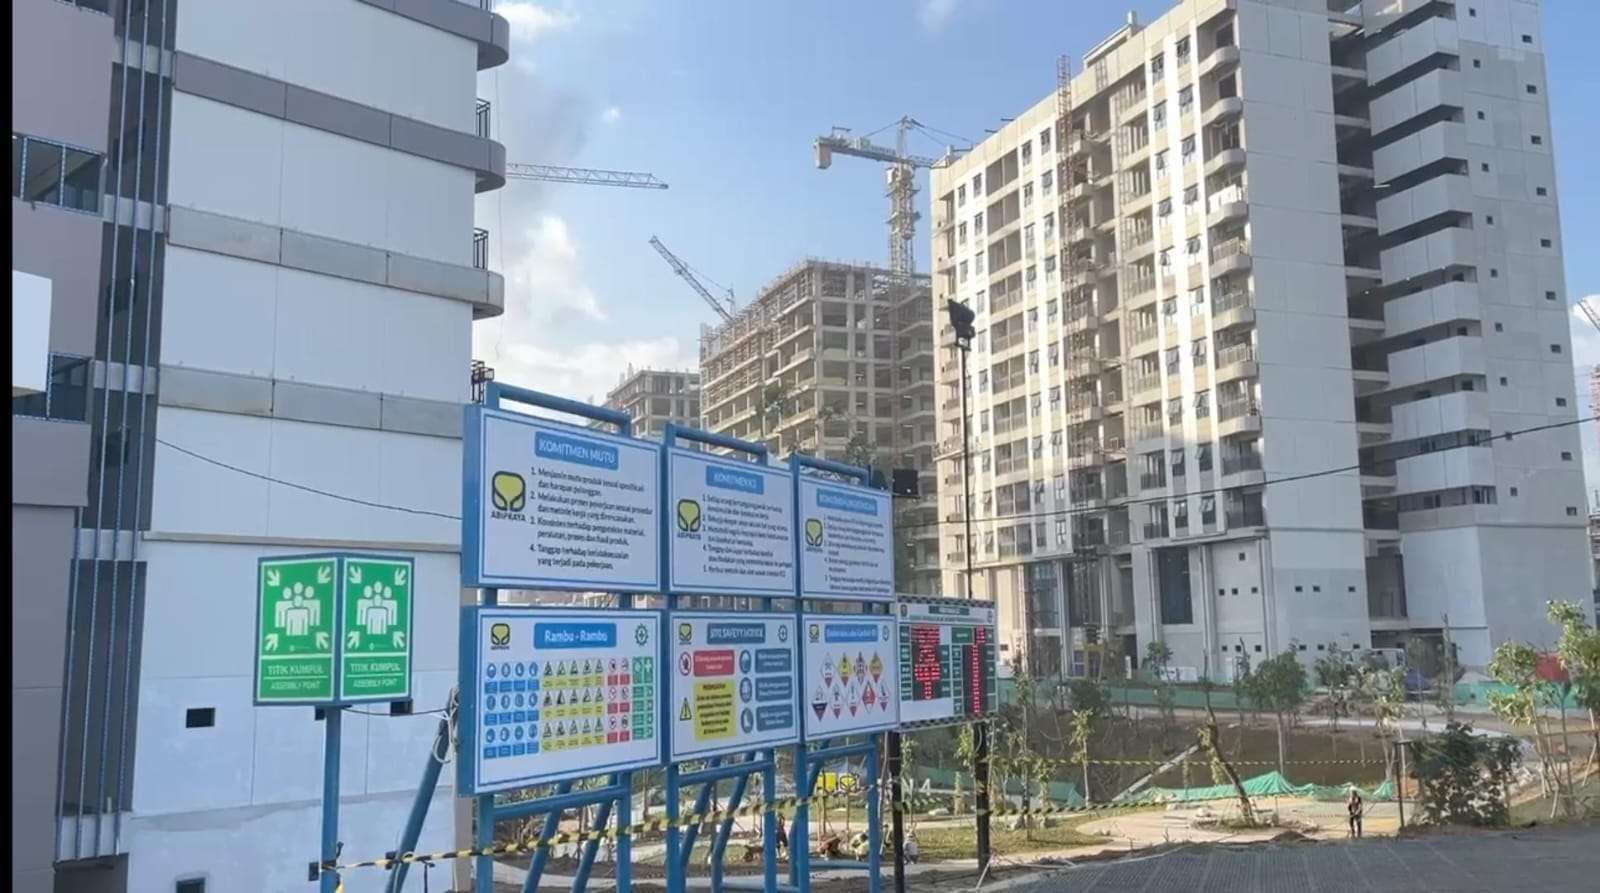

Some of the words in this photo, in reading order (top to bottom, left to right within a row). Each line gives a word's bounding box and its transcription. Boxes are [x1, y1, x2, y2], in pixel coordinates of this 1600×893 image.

[538, 438, 588, 459] KOMITMEN
[589, 448, 616, 465] MUTU
[491, 510, 527, 522] ABIPRAYA
[544, 629, 574, 642] Rambu
[580, 629, 608, 642] Rambu
[723, 627, 743, 639] SAFETY
[267, 664, 289, 676] TITIK
[289, 663, 325, 675] KUMPUL
[350, 662, 369, 673] TITIK
[369, 662, 401, 672] KUMPUL
[302, 679, 321, 690] POINT
[381, 677, 398, 688] POINT
